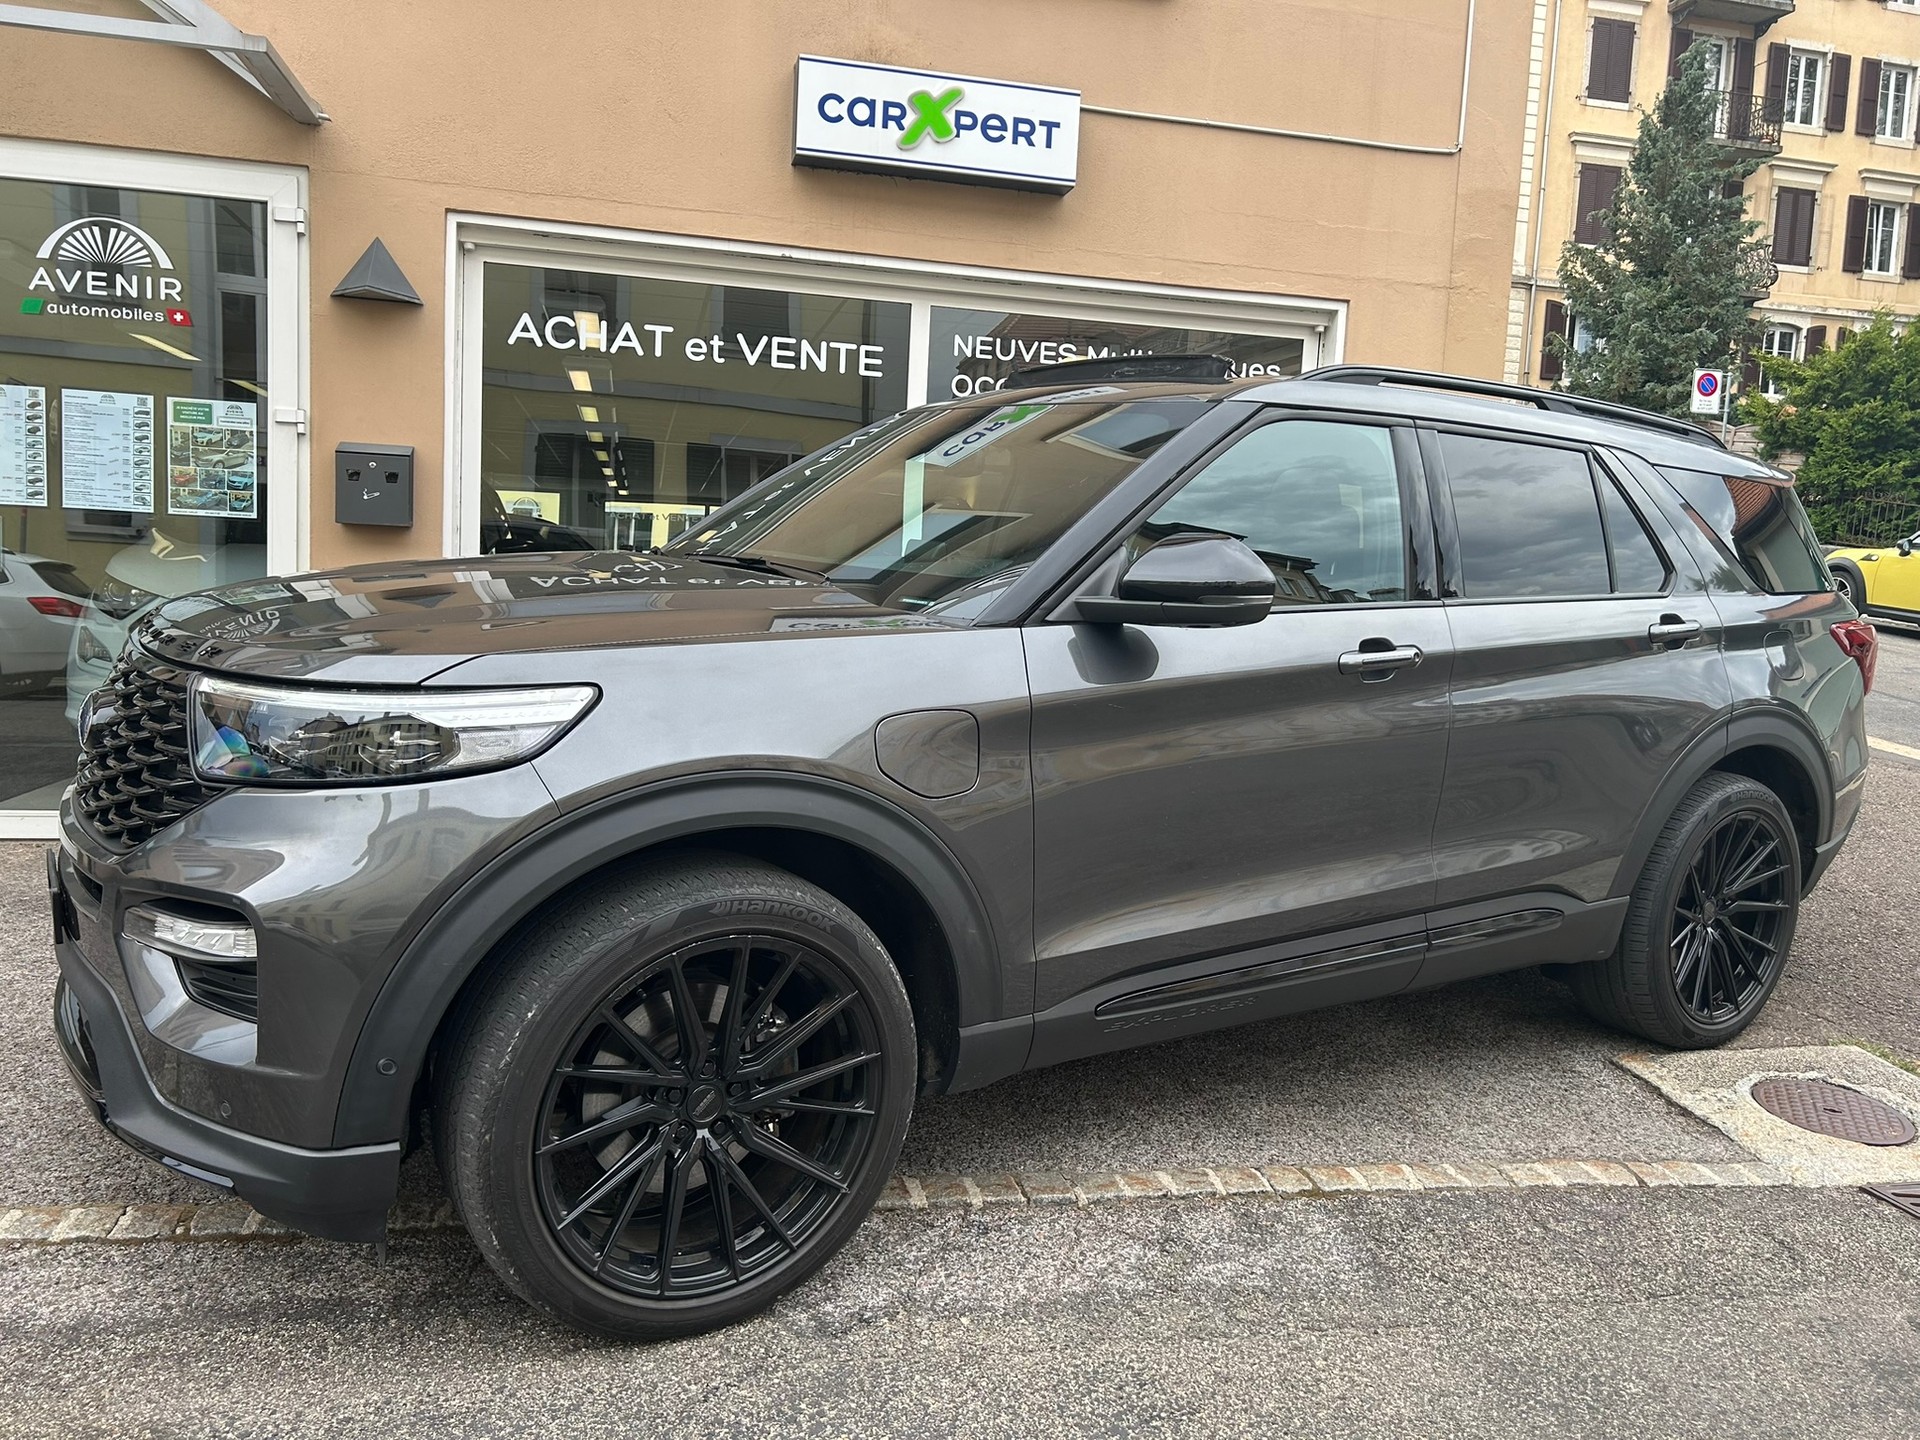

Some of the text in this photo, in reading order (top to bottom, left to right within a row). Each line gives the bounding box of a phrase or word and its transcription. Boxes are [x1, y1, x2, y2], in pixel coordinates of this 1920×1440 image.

[28, 266, 182, 302] AVENIR
[46, 302, 165, 322] automobiles
[507, 312, 884, 377] ACHAT et VENTE
[953, 334, 1077, 364] NEUVES
